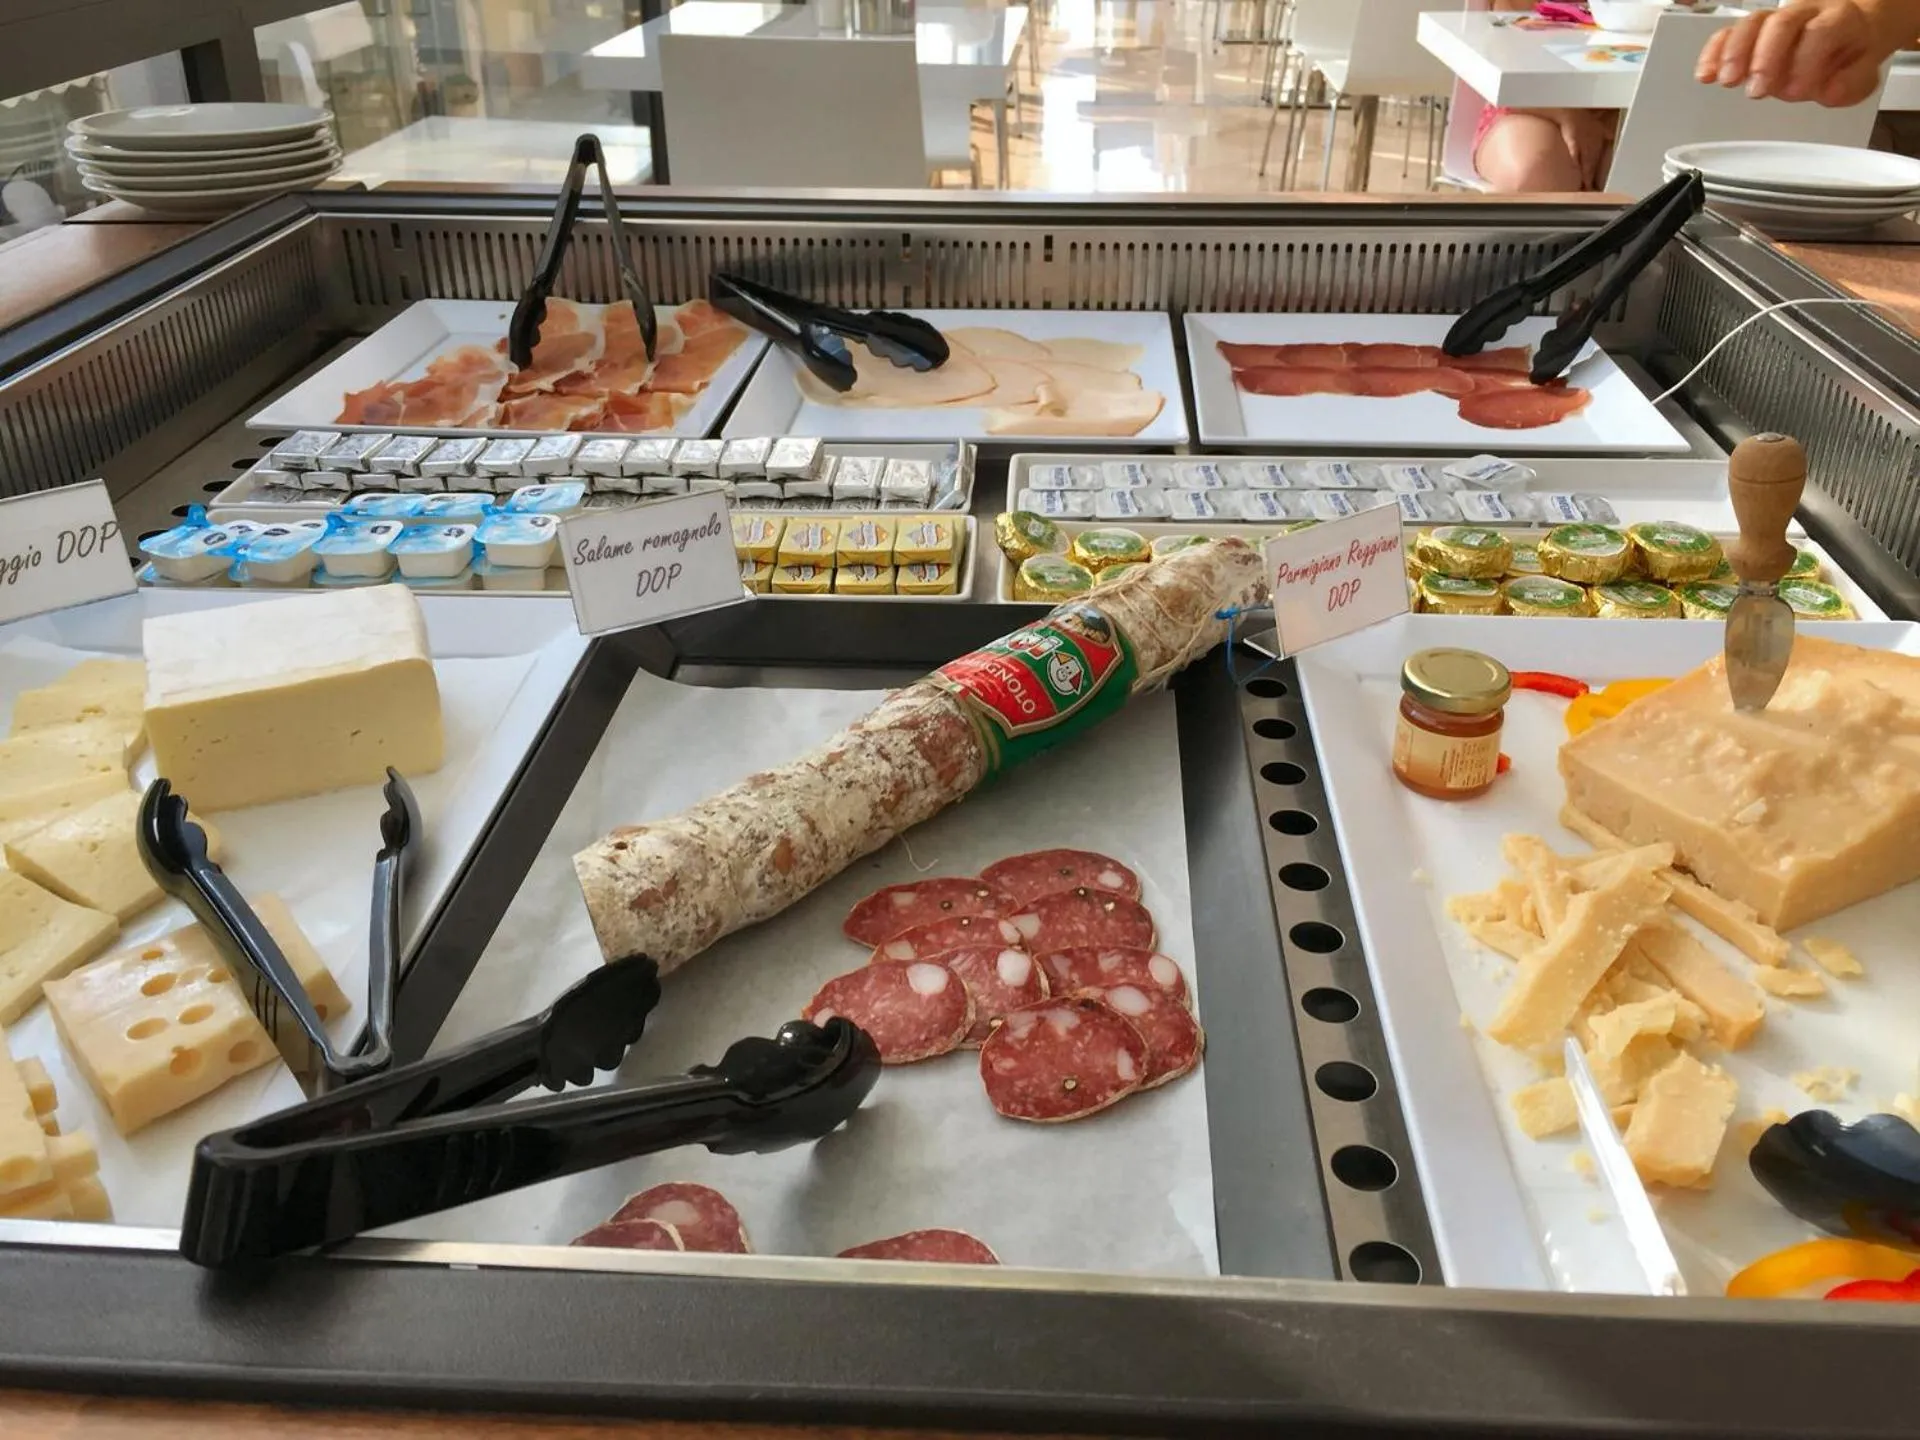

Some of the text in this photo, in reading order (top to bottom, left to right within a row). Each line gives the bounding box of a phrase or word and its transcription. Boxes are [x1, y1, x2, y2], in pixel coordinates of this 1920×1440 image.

[56, 520, 119, 564] DOP
[573, 535, 635, 566] Salame
[641, 511, 722, 553] romagnolo
[636, 562, 682, 598] DOP
[1276, 535, 1399, 589] Parmigiano Reggiano
[1327, 578, 1362, 612] DOP
